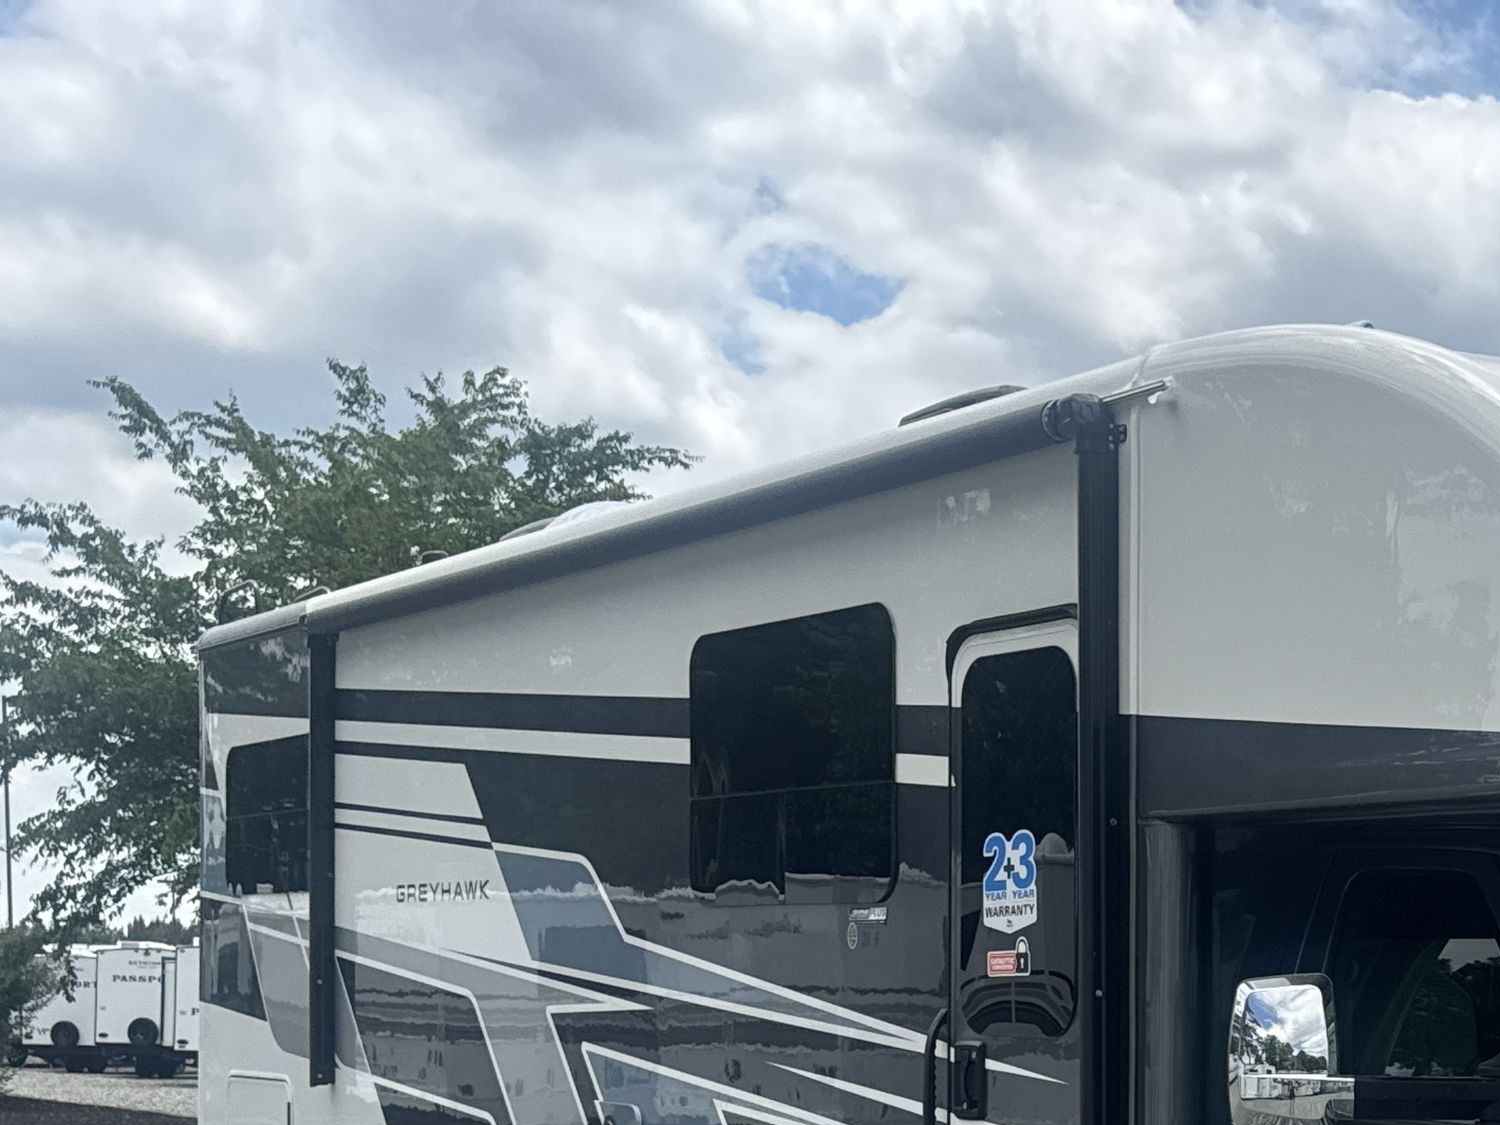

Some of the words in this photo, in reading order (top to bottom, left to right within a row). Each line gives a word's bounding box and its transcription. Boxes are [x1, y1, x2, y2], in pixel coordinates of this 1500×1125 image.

[396, 880, 490, 903] GREYHAWK
[985, 892, 1007, 901] YEAR
[1012, 889, 1035, 899] YEAR
[985, 904, 1035, 919] WARRANTY
